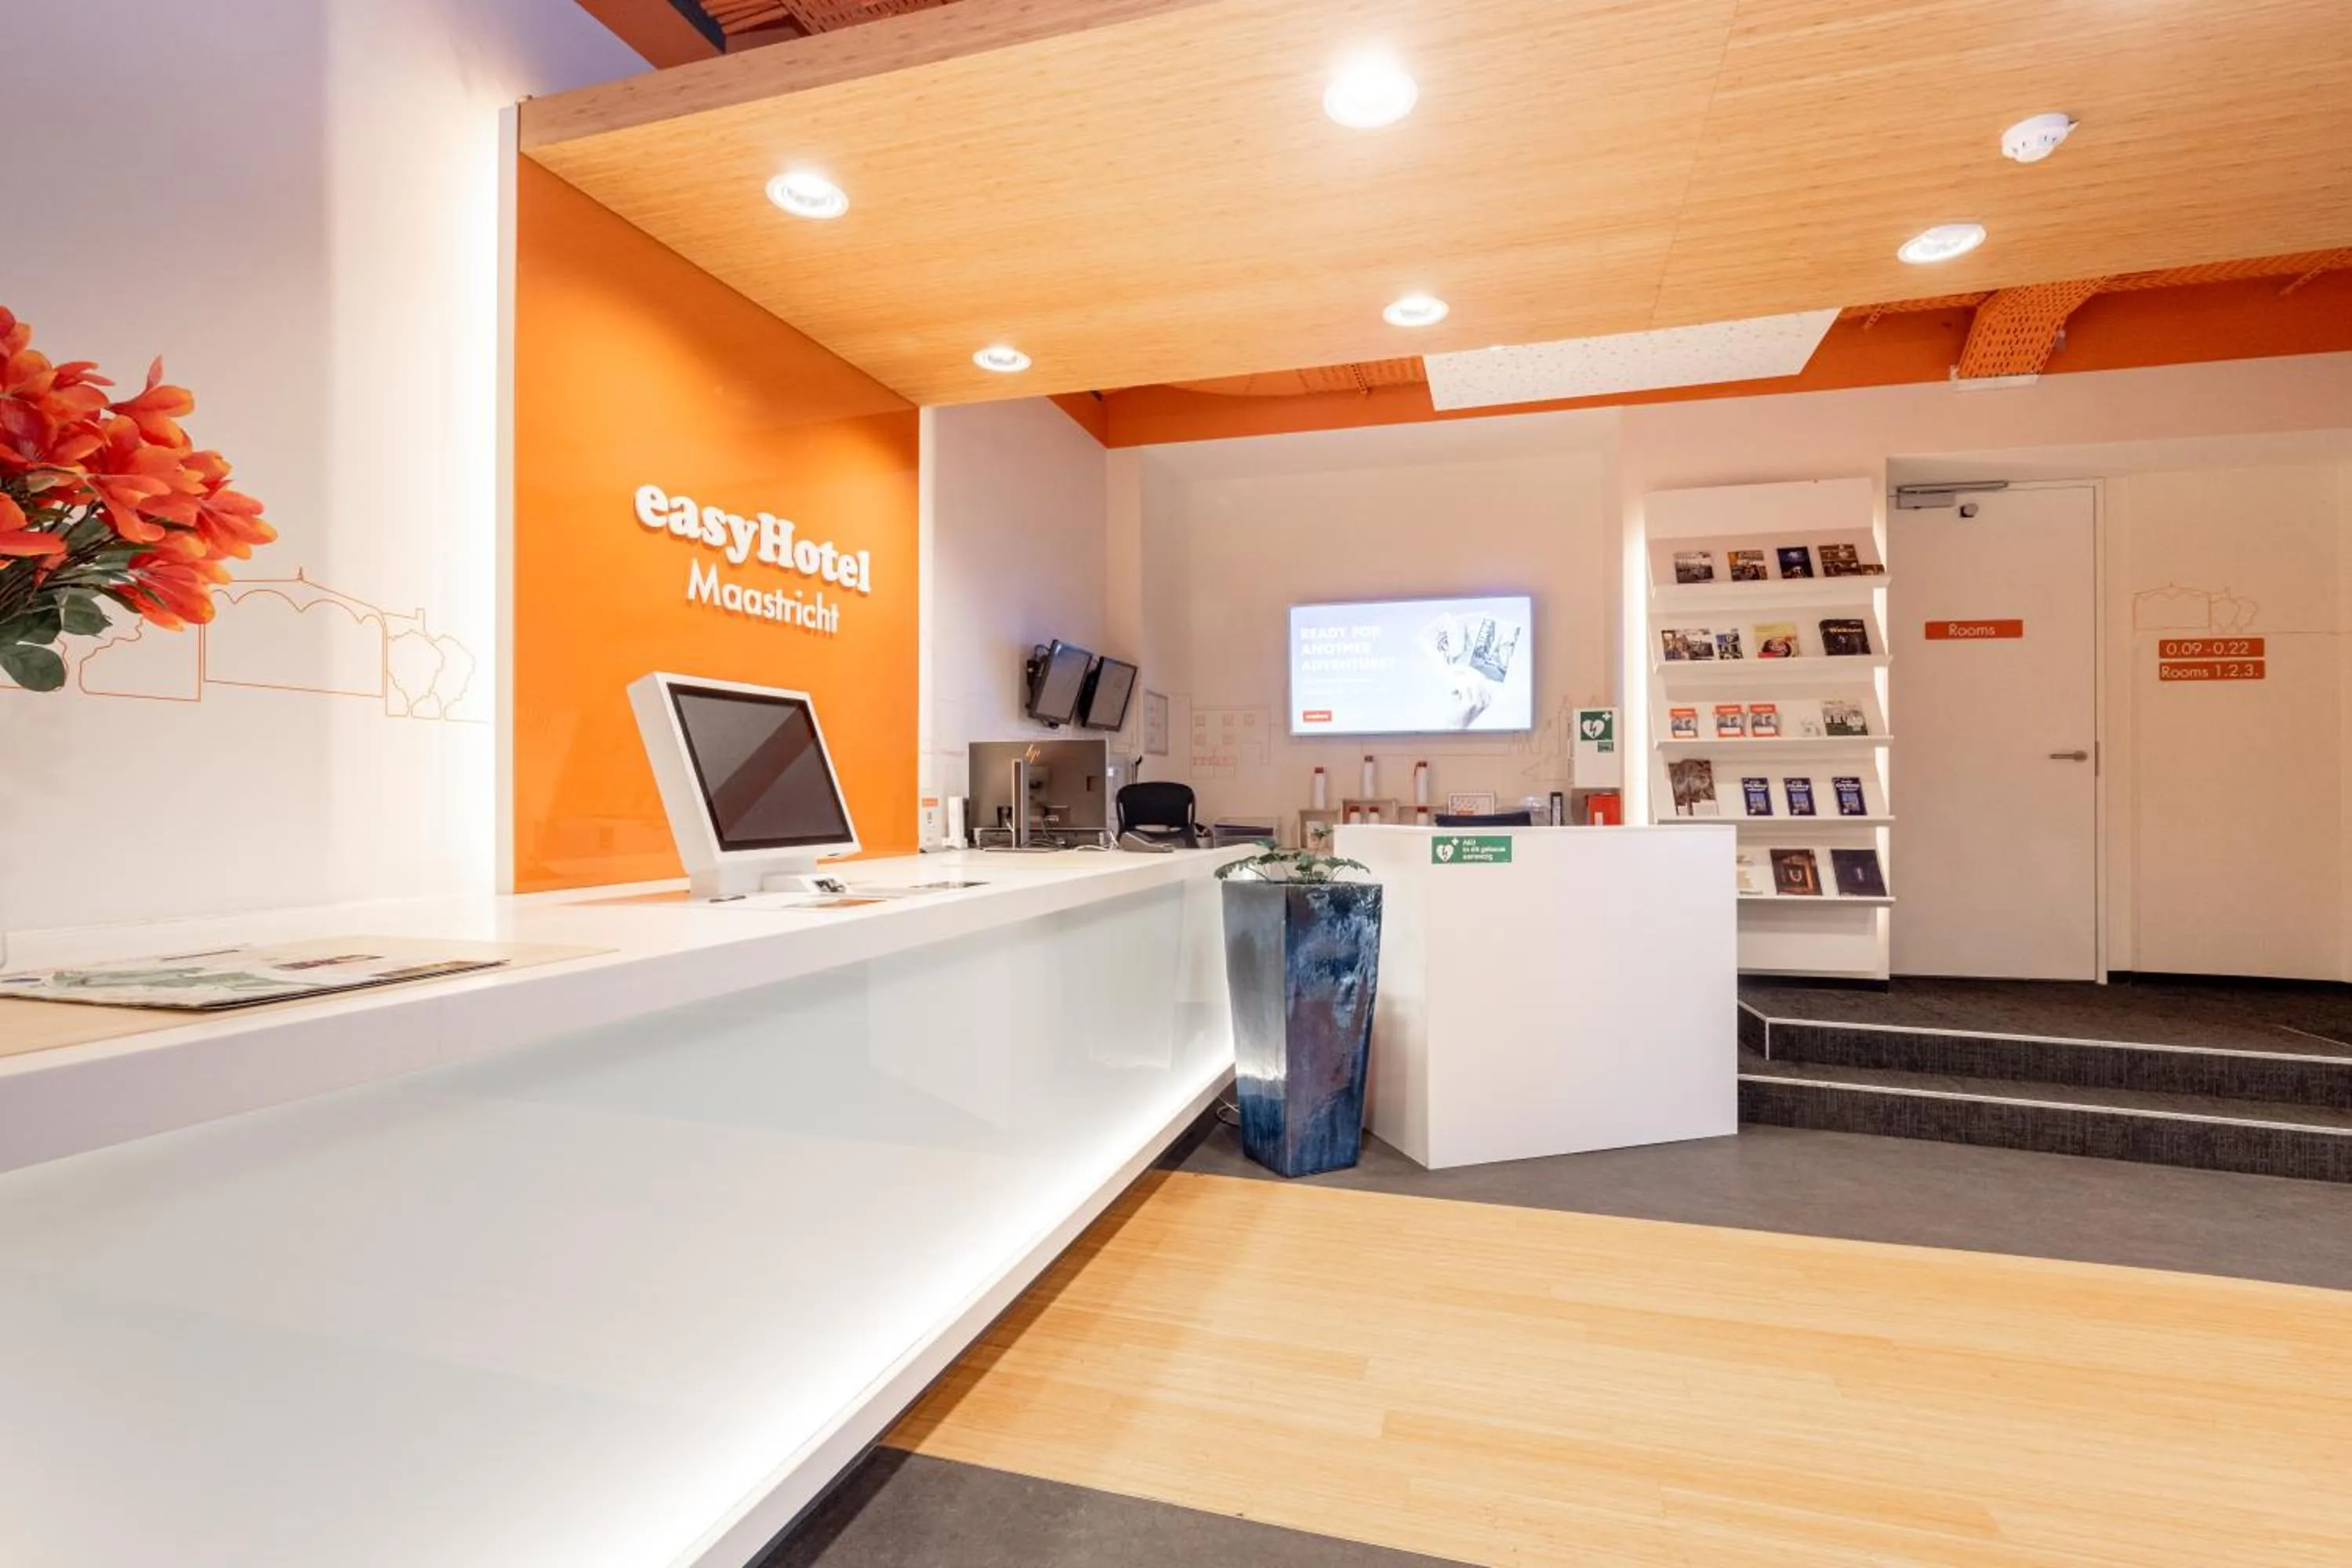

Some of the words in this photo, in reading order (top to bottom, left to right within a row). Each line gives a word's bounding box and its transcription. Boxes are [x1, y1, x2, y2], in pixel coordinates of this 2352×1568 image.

[634, 485, 871, 593] easyHotel
[687, 557, 839, 633] Maastricht
[1948, 622, 1995, 637] Rooms
[2161, 665, 2209, 678] Rooms
